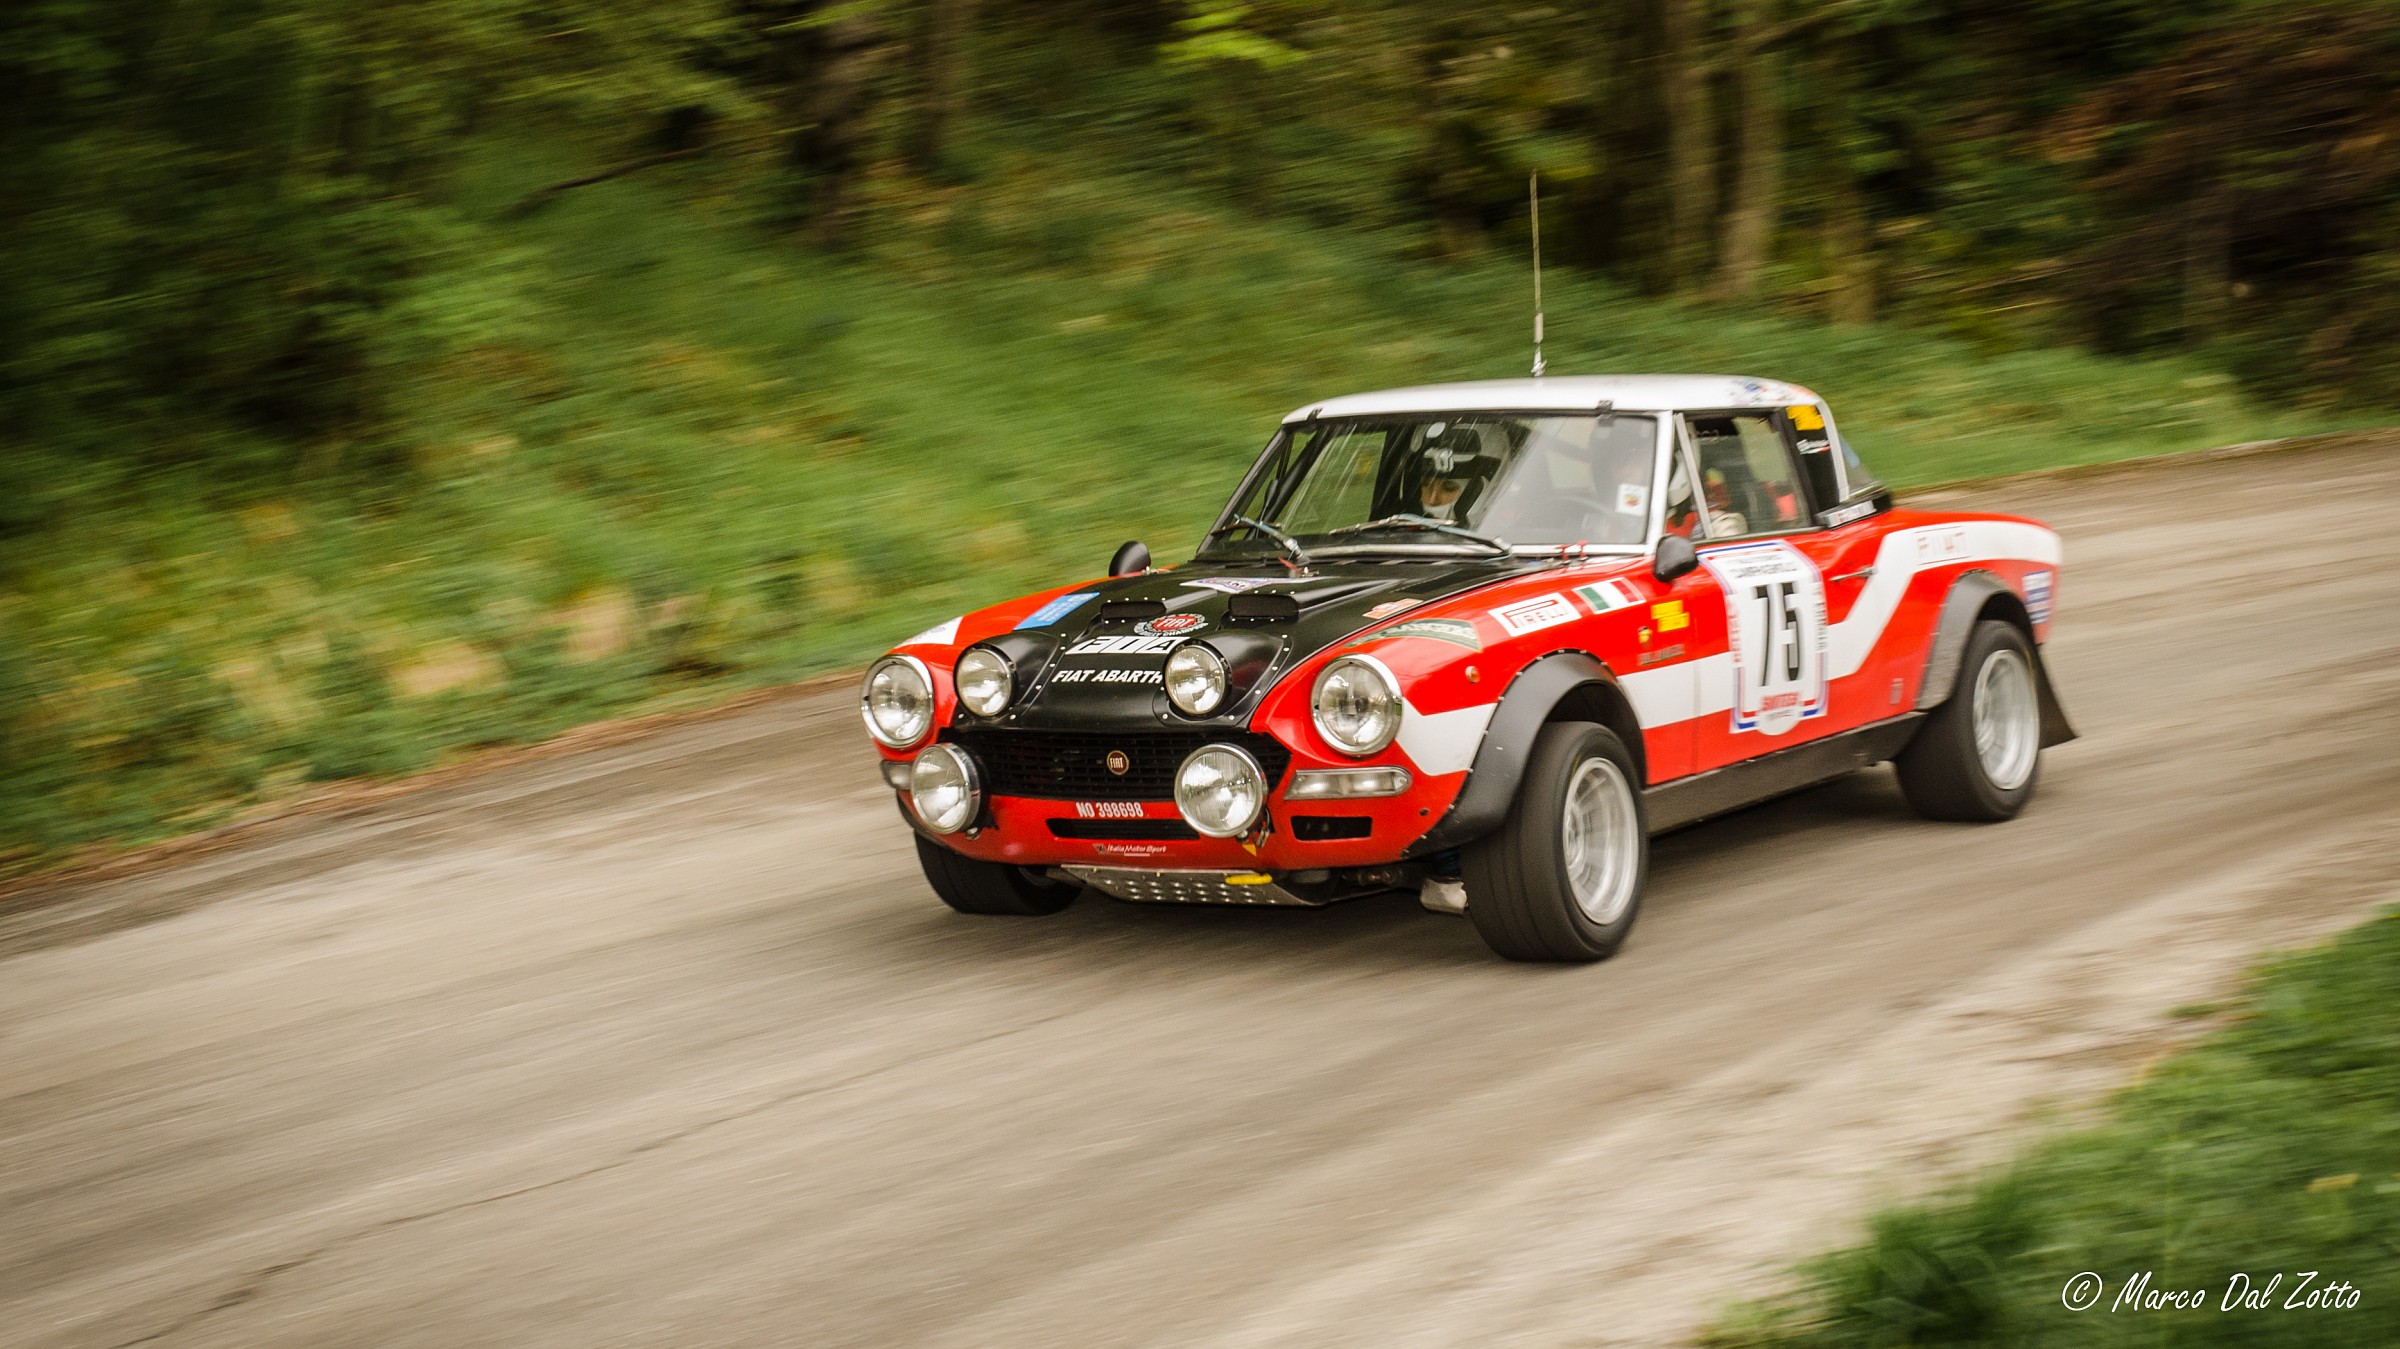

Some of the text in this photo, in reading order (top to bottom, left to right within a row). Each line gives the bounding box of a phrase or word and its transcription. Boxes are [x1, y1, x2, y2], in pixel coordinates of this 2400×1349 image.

[1156, 618, 1194, 627] FIAT
[1752, 581, 1802, 687] 75
[1070, 637, 1186, 653] FIA
[1051, 670, 1163, 684] FIAT ABARTH
[1109, 757, 1124, 768] FIAT
[1076, 802, 1144, 817] NO 398698
